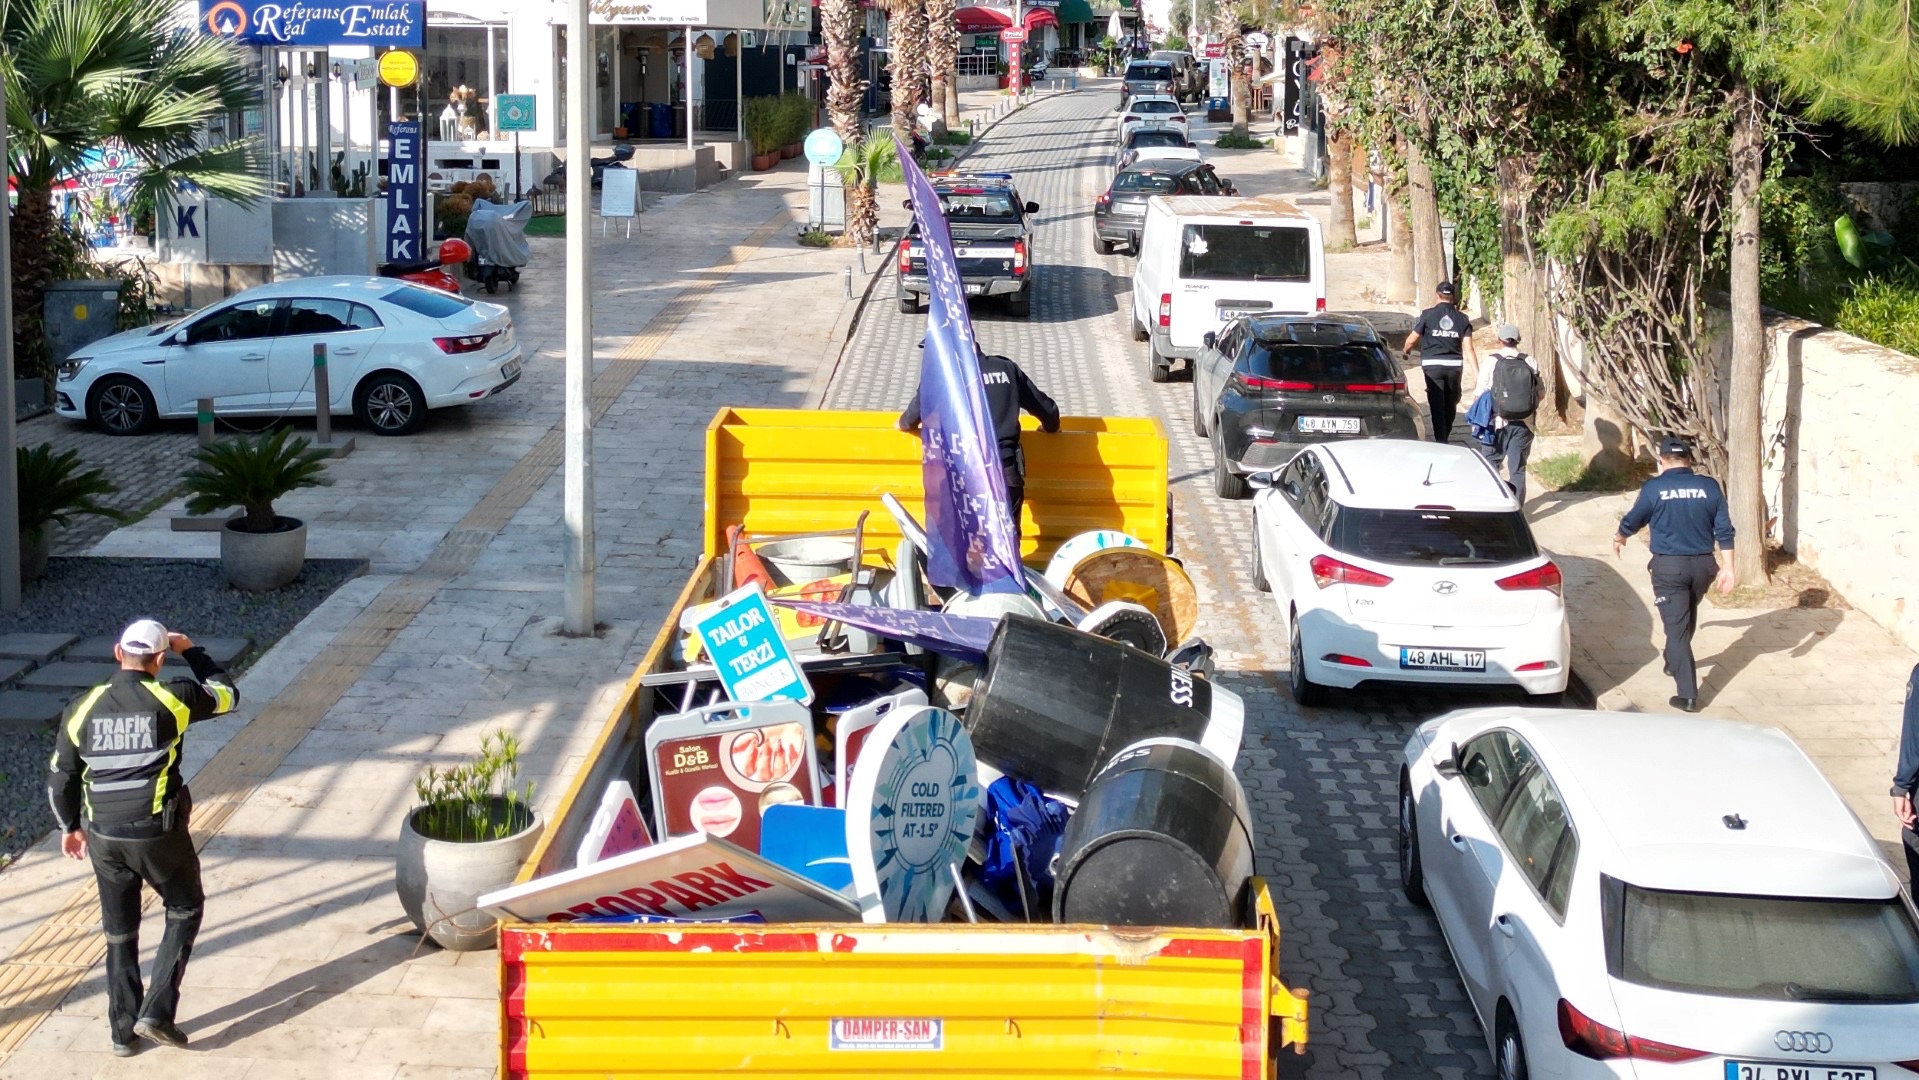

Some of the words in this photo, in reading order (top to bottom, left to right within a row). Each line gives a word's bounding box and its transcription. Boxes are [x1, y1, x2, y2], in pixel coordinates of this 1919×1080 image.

[253, 2, 340, 41] Referans
[340, 3, 414, 36] Emlak
[391, 138, 414, 260] EMLAK
[1431, 329, 1460, 338] ZABITA
[1321, 419, 1337, 430] AYN
[1342, 419, 1359, 430] 759
[1659, 488, 1707, 500] ZABITA
[708, 607, 765, 647] TAILOR
[728, 637, 777, 677] TERZİ
[1408, 652, 1425, 664] 48
[1430, 653, 1459, 666] AHL
[1464, 654, 1483, 667] 117
[92, 714, 152, 735] TRAFİK
[91, 732, 154, 751] ZABITA
[679, 745, 702, 753] Salon
[673, 750, 710, 768] D&B
[911, 782, 940, 797] COLD
[901, 802, 945, 818] FILTERED
[842, 1016, 931, 1040] DAMPER-SAN
